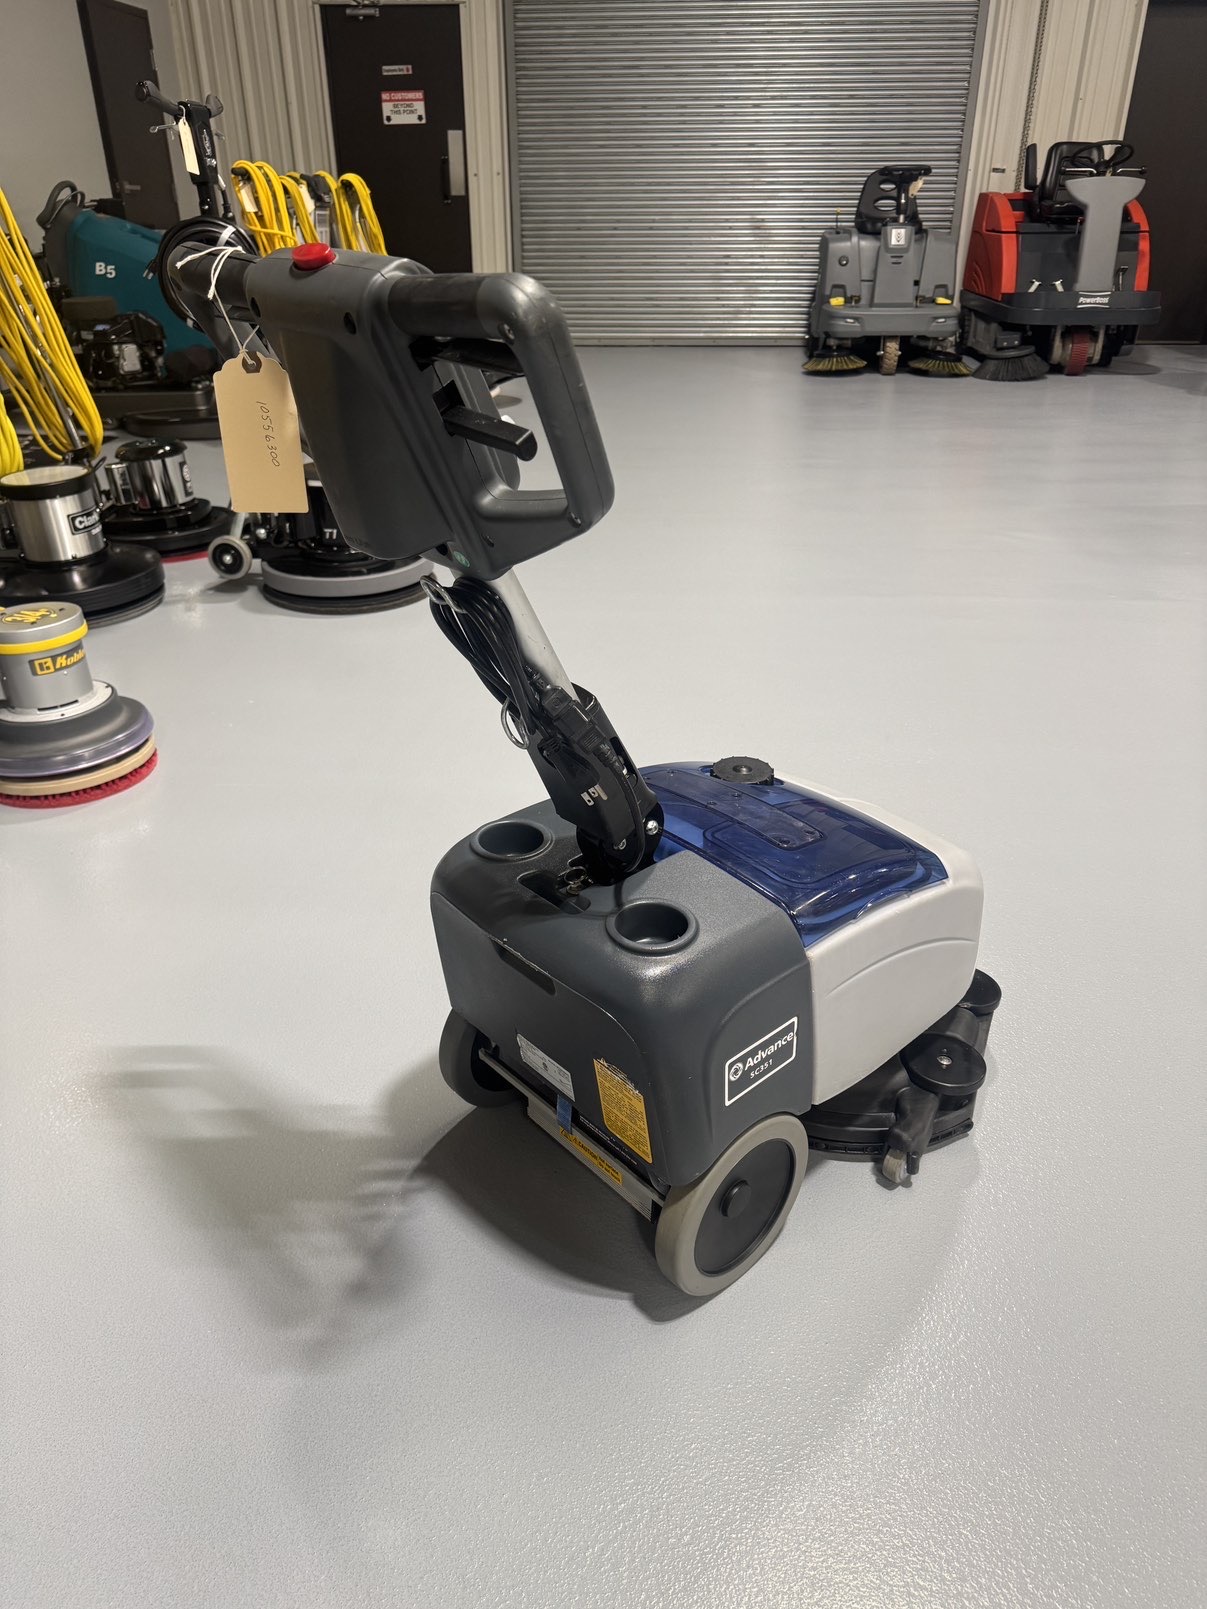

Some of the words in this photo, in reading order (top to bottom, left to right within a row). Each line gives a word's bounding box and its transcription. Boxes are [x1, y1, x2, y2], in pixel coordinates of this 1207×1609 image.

[95, 262, 116, 278] B5
[256, 400, 281, 467] 10556300
[744, 1031, 794, 1071] Advance
[749, 1059, 773, 1079] SC351
